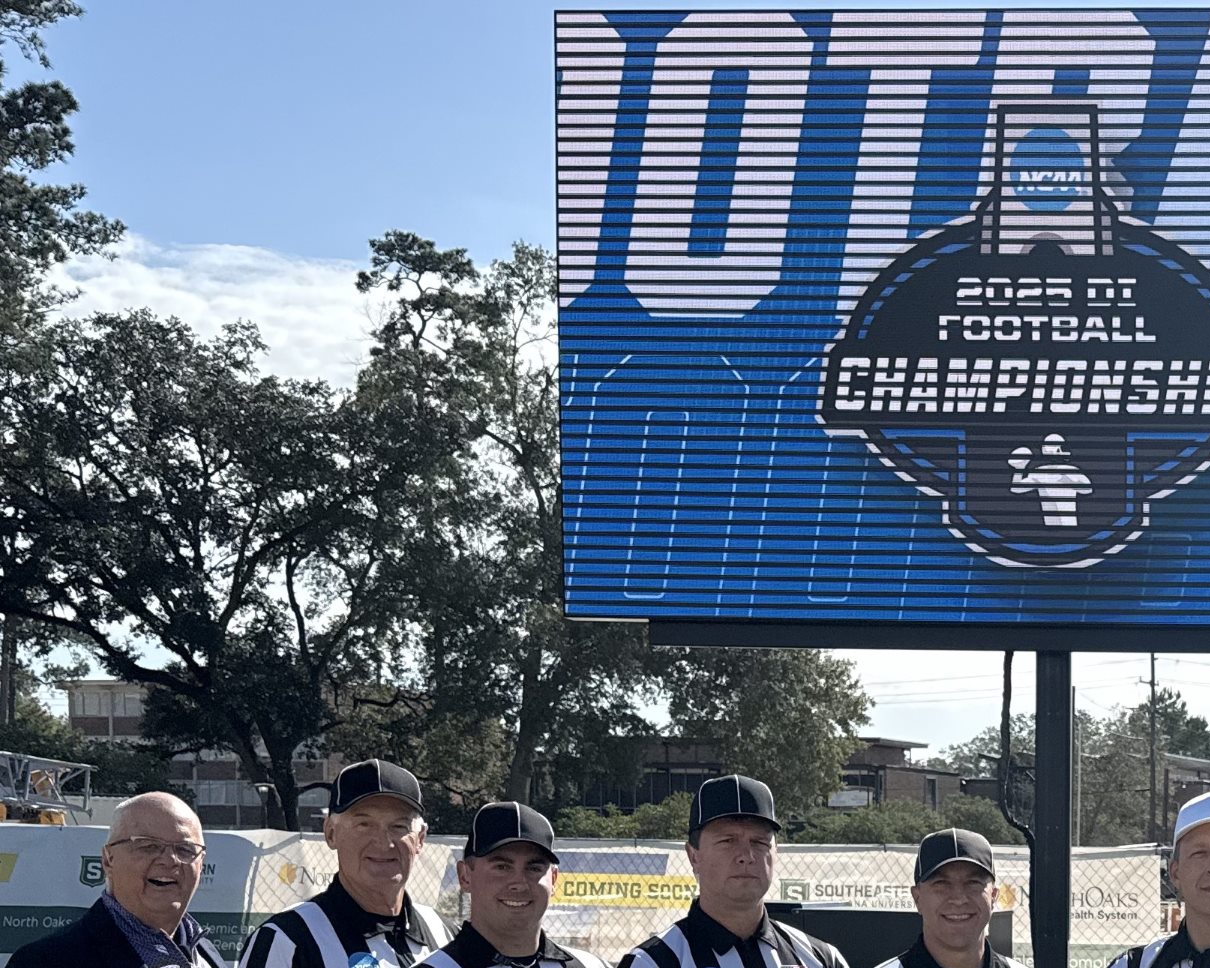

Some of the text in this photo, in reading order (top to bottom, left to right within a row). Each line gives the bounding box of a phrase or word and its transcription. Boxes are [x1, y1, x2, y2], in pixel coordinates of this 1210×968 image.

[1017, 170, 1082, 192] NCAA
[956, 277, 1138, 307] 2025 DI
[938, 315, 1157, 342] FOOTBALL
[563, 880, 698, 900] COMING SOON
[815, 884, 909, 898] SOUTHEASTE
[3, 916, 39, 927] North
[1097, 909, 1138, 921] System
